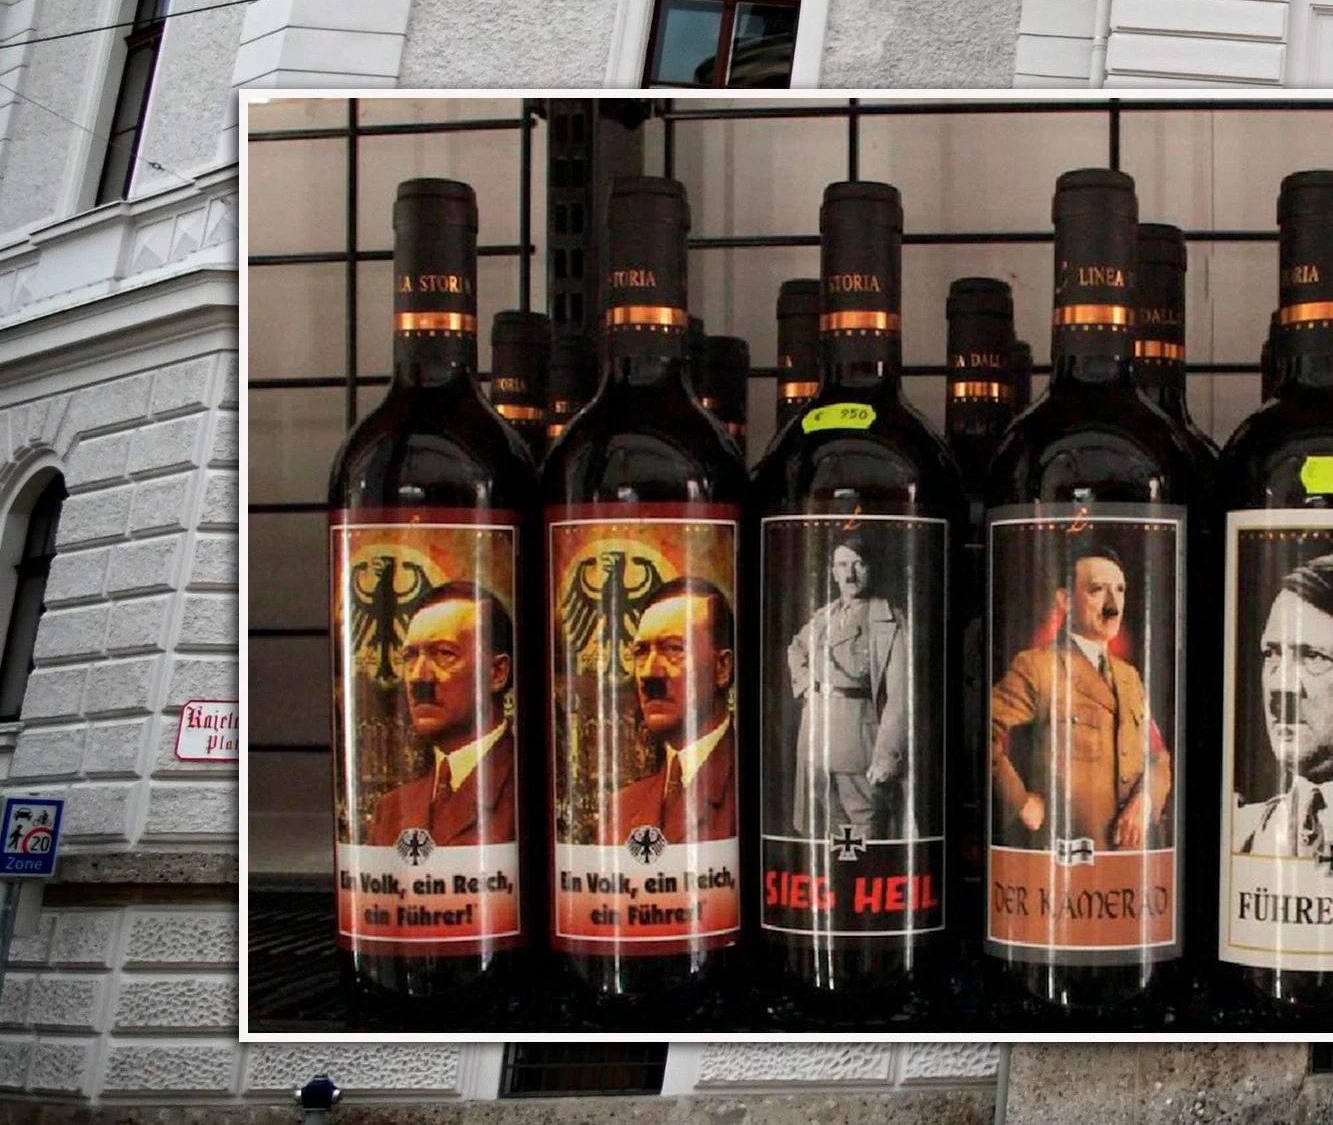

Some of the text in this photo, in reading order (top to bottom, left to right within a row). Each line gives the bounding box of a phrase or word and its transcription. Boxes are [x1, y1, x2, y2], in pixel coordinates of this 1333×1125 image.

[1079, 267, 1125, 287] LINEA
[31, 835, 51, 852] 20
[5, 856, 44, 870] Zone
[765, 870, 939, 915] SIEG HEIL
[994, 881, 1030, 917] DER
